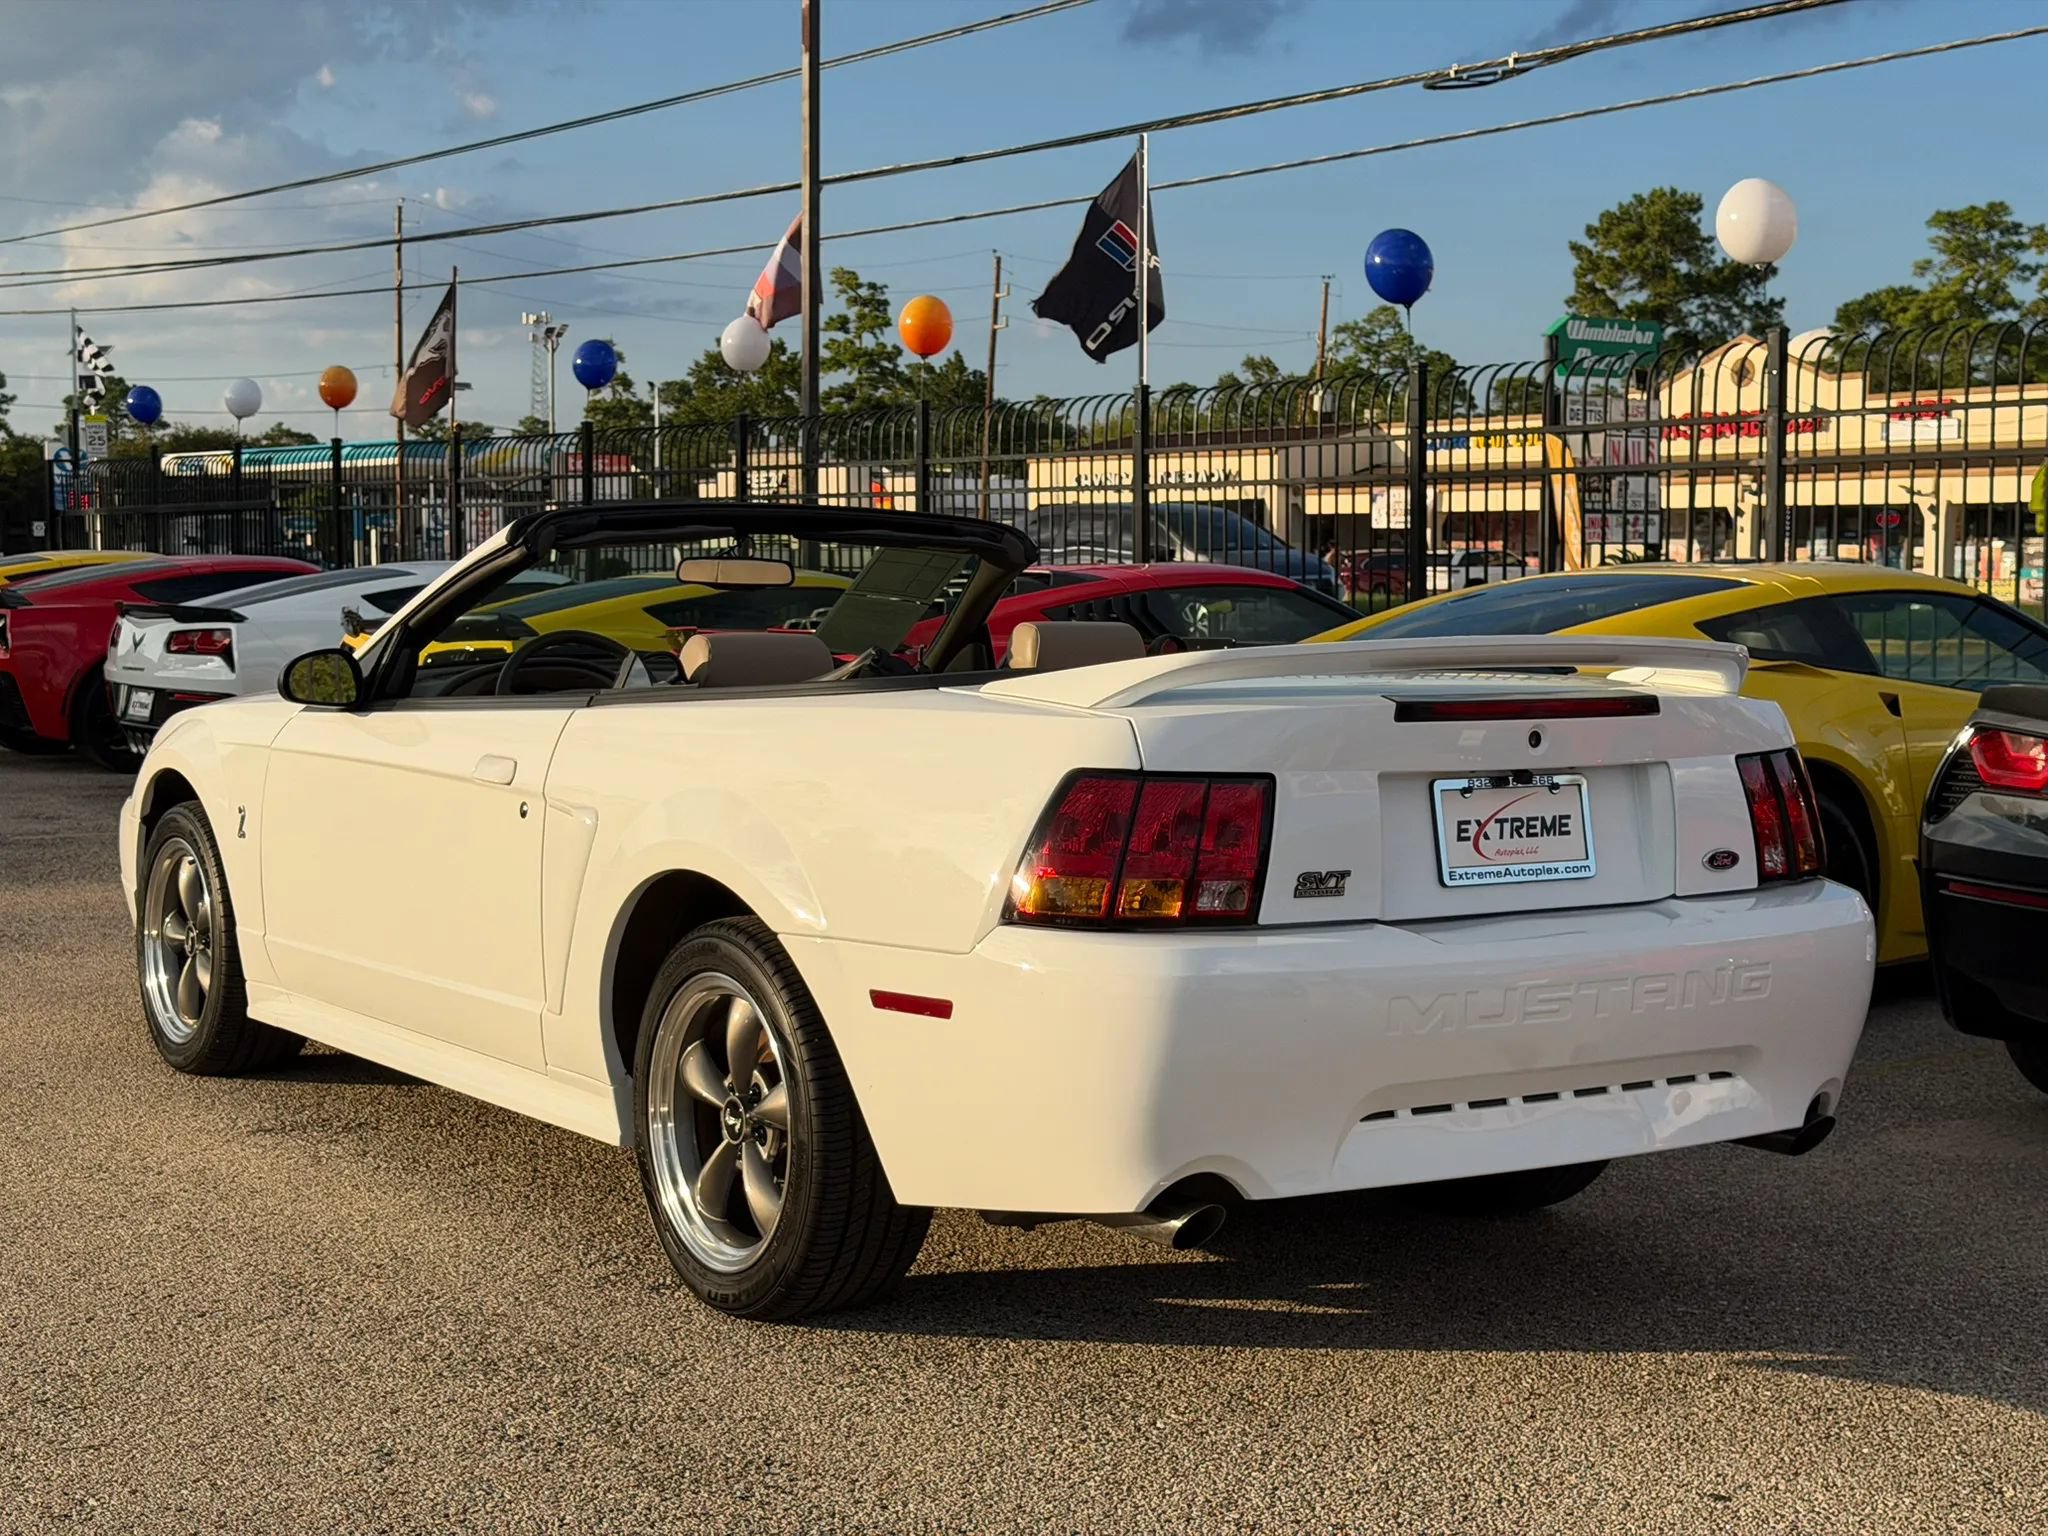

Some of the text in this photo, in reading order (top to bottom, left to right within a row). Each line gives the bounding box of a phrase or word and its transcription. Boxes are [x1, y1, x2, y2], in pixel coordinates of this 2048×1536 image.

[1567, 320, 1654, 345] Wimbledon
[88, 435, 106, 446] 25
[1456, 814, 1572, 842] EXTREME
[1295, 870, 1352, 889] SVT
[1449, 864, 1592, 882] ExtremeAutoplex.com
[1386, 961, 1772, 1036] MUSTANG
